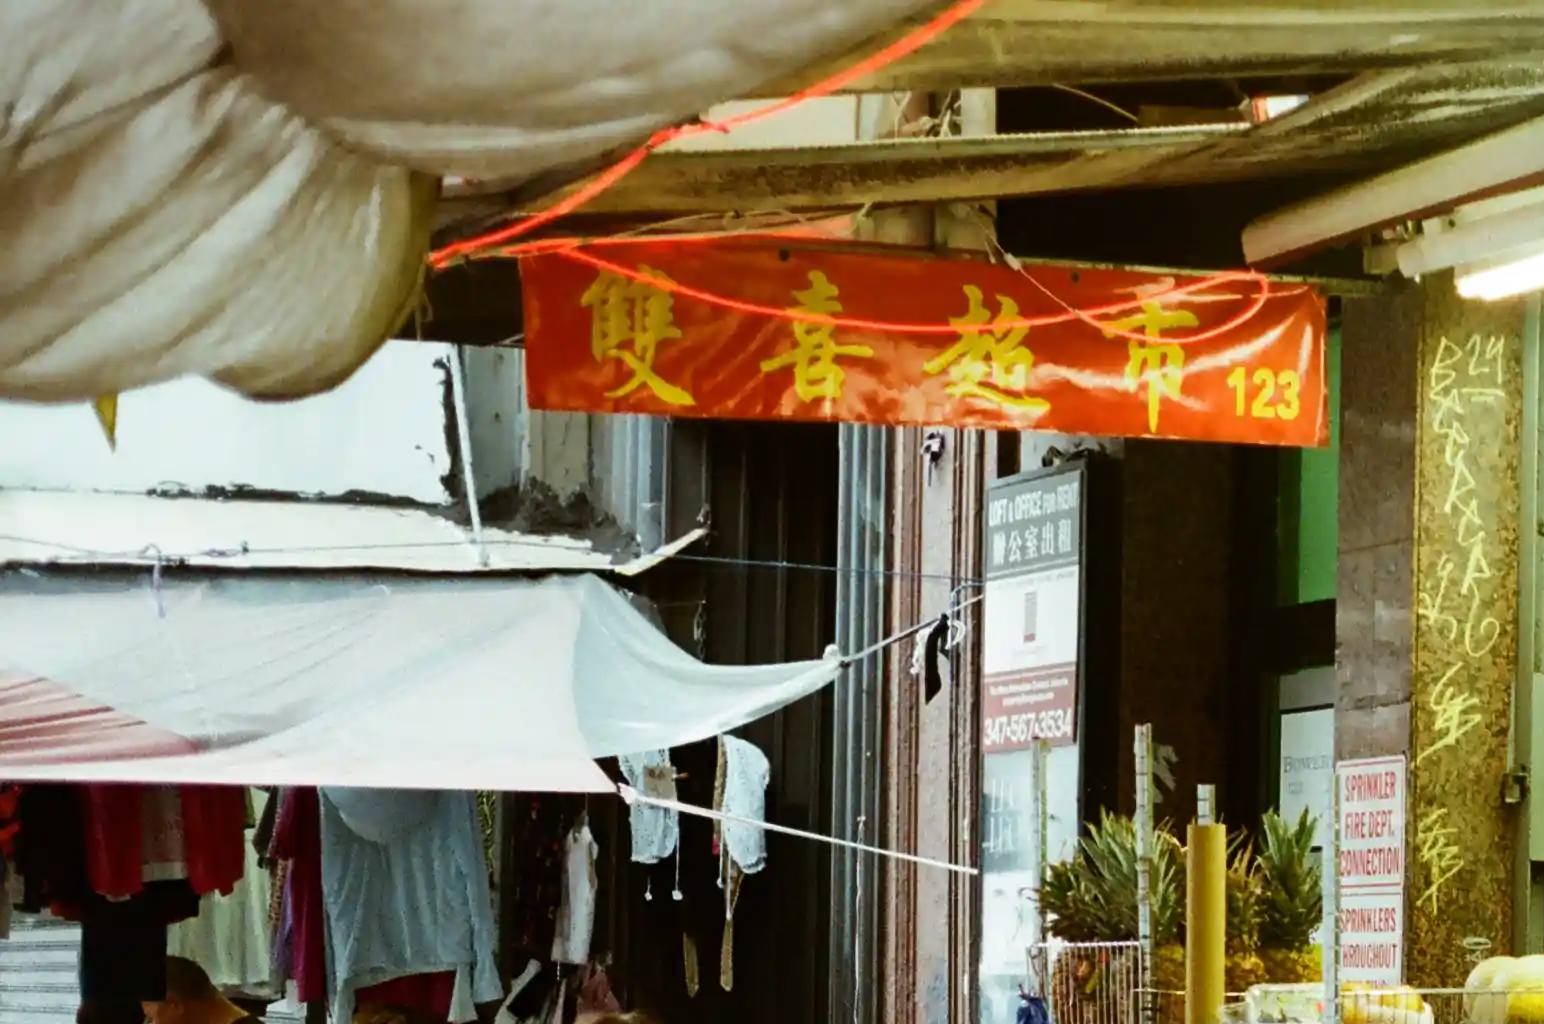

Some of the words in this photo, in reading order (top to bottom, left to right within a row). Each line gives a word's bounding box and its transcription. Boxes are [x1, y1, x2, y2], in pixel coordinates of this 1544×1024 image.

[580, 264, 1197, 433] 雙喜超市
[1227, 366, 1300, 420] 123
[1014, 490, 1042, 520] OFFICE
[1345, 771, 1396, 802] SPRINKLER
[1345, 811, 1366, 840] FIRE
[1368, 809, 1395, 838] DEPT.
[1340, 847, 1400, 877] CONNECTION
[1340, 907, 1396, 933] SPRINKLERS
